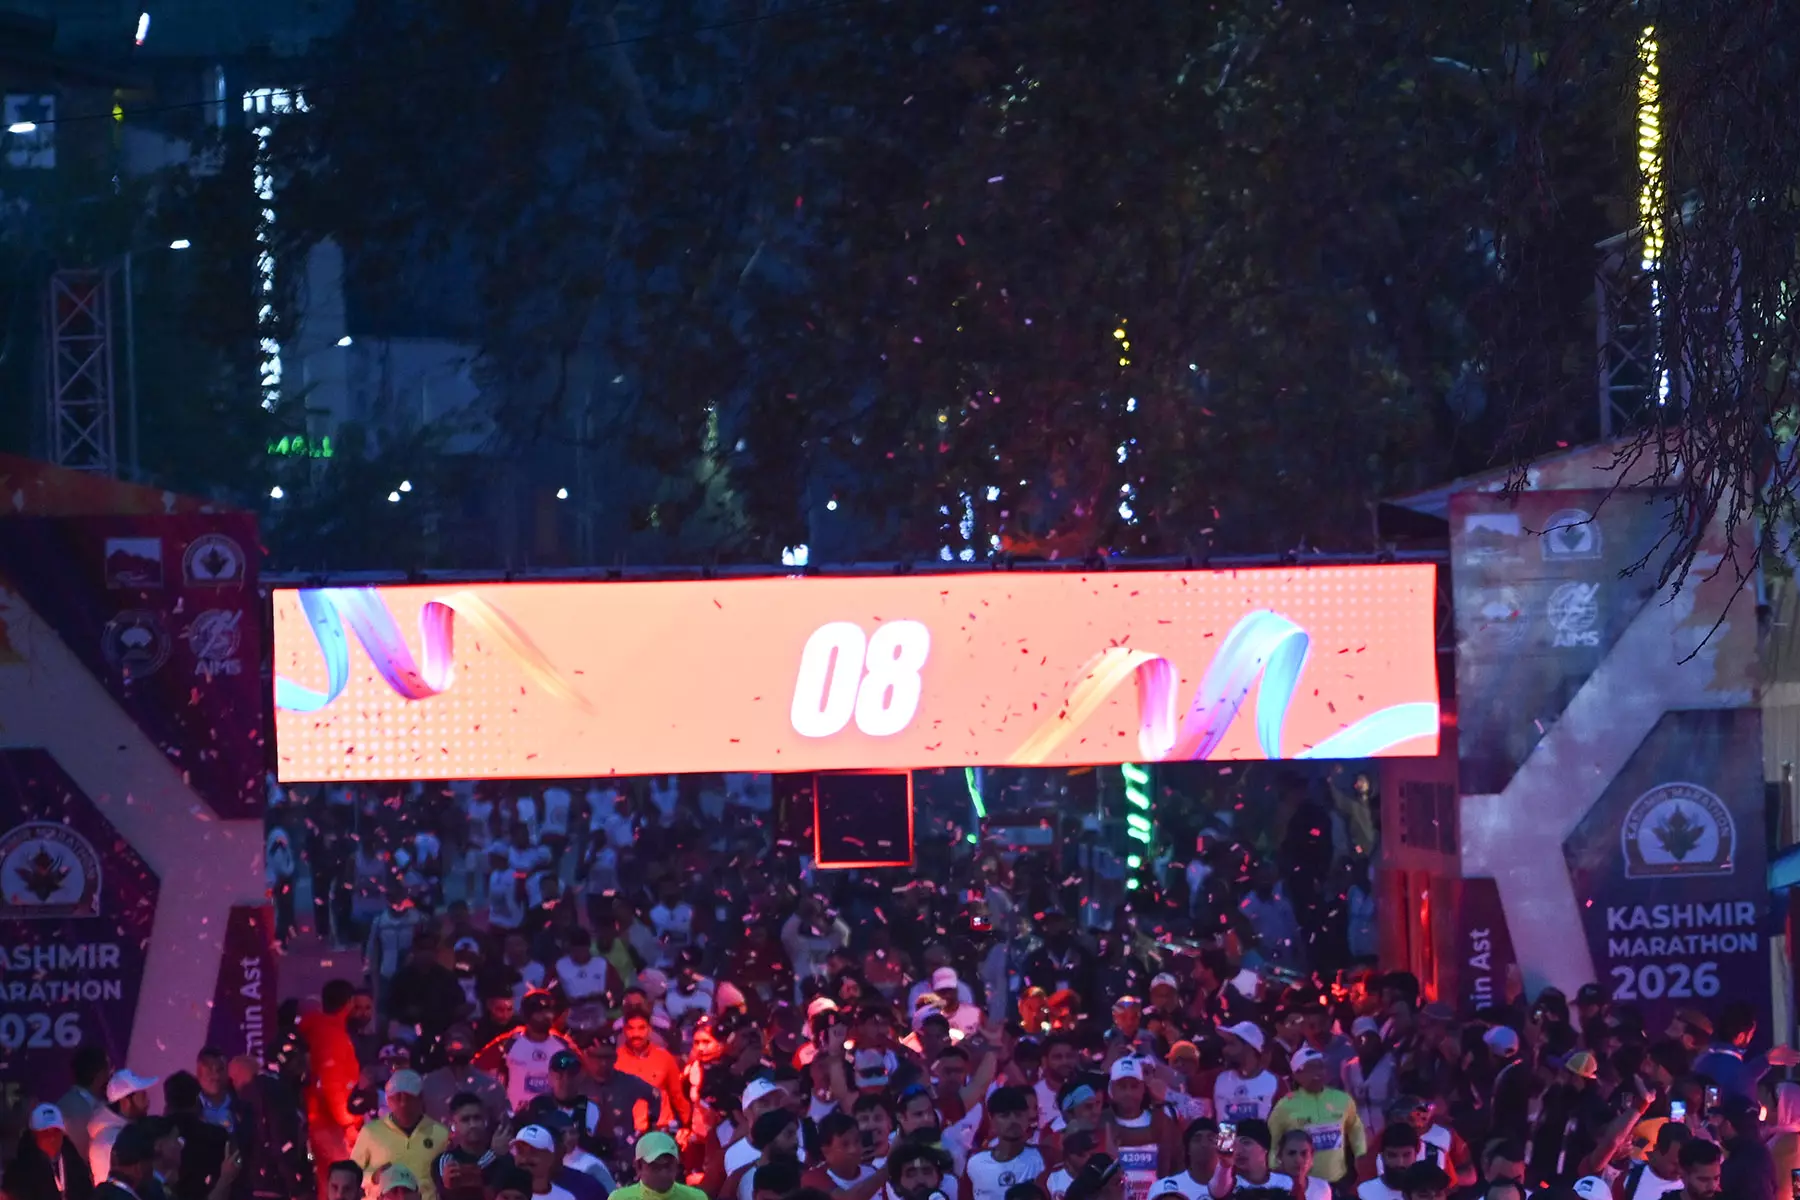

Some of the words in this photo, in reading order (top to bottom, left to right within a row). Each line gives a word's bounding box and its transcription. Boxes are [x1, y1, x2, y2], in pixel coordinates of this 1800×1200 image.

[790, 620, 930, 738] 08
[1606, 901, 1756, 932] KASHMIR
[0, 943, 120, 970] ASHMIR
[1469, 928, 1492, 971] Ast
[1607, 931, 1758, 958] MARATHON
[0, 980, 122, 1001] ARATHON
[240, 956, 262, 1000] Ast
[1610, 961, 1722, 1001] 2026
[0, 1012, 82, 1050] 026
